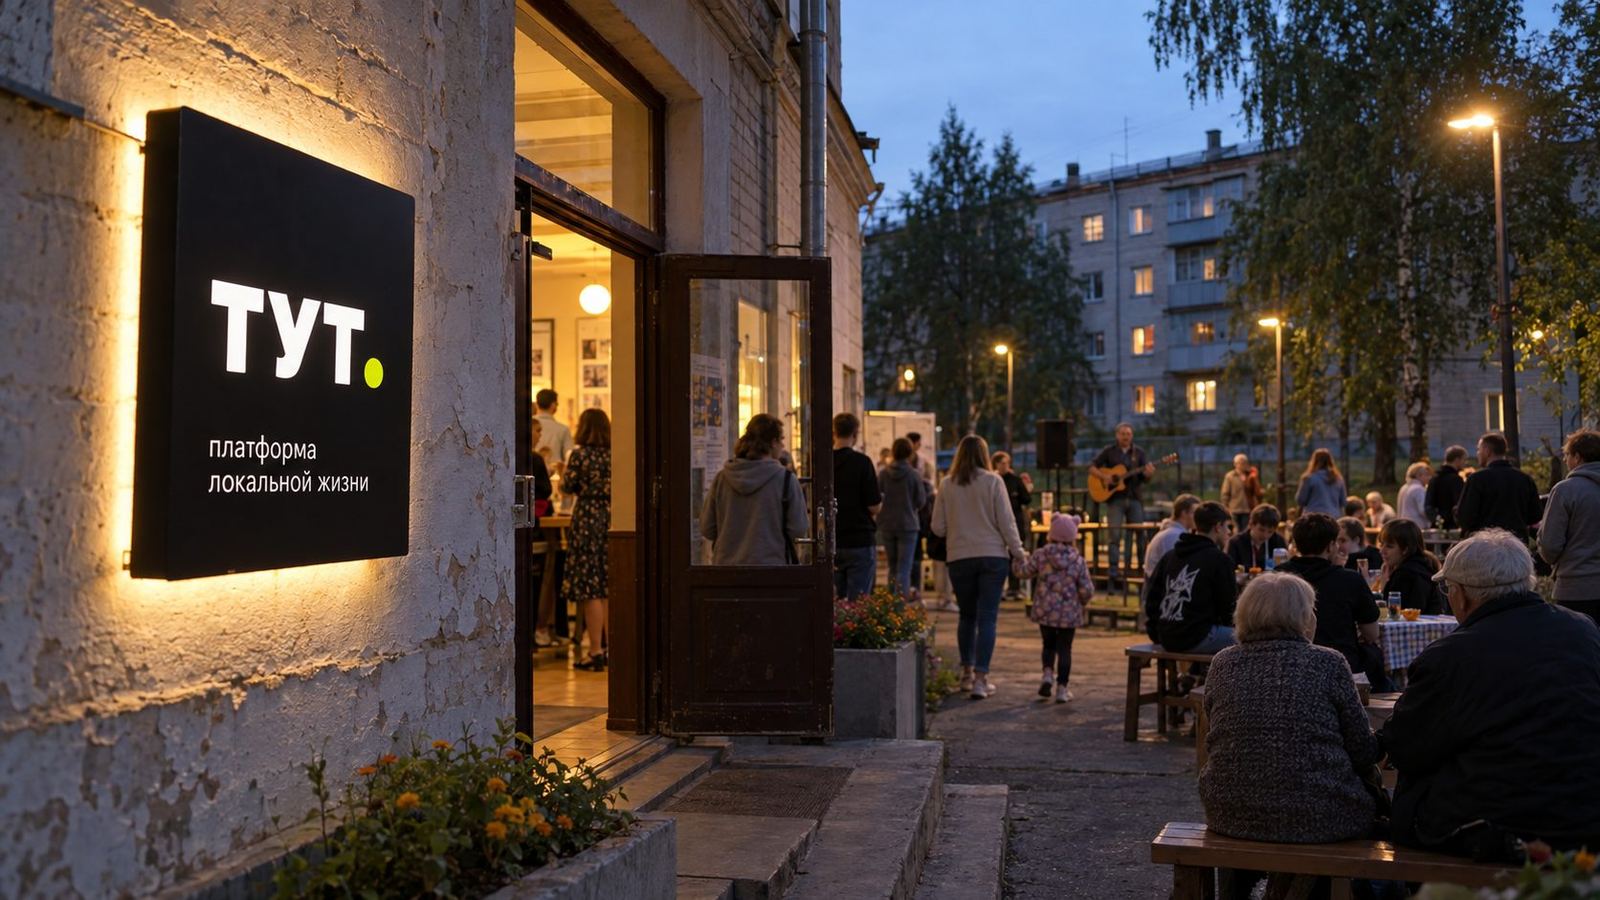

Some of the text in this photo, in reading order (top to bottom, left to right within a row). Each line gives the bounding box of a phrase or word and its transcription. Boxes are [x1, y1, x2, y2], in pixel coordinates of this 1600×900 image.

[210, 278, 384, 389] ТУТ.
[208, 434, 317, 466] платформа
[208, 470, 369, 493] локальной жизни
